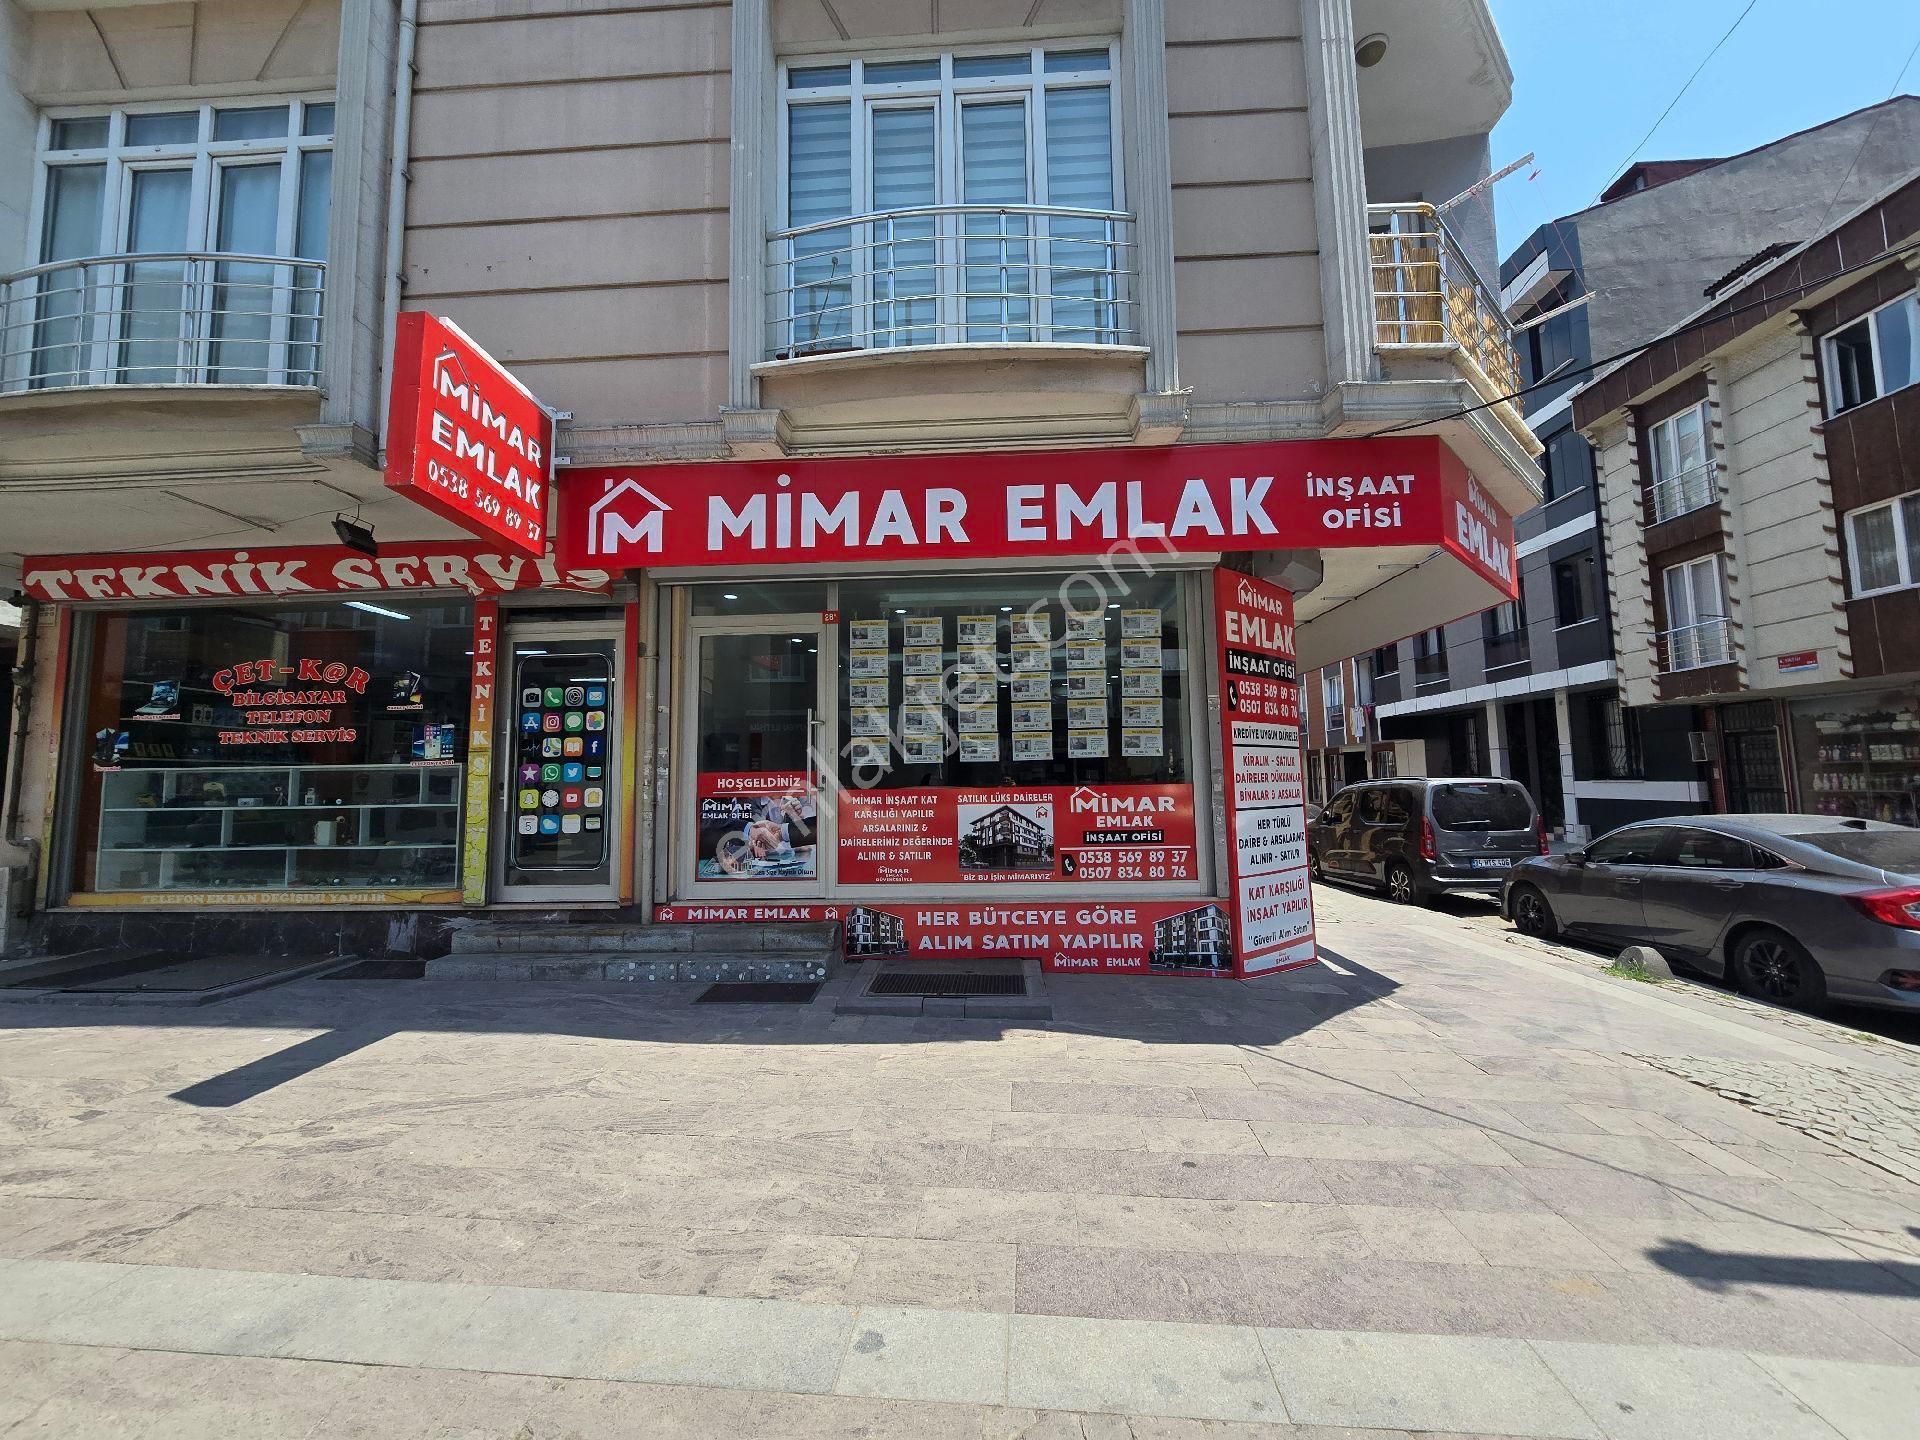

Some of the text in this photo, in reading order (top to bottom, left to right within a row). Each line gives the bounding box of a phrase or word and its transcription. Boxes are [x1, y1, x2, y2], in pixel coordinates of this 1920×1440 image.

[441, 367, 542, 468] MİMAR
[432, 408, 542, 511] EMLAK
[1306, 472, 1415, 502] İNŞAAT
[428, 458, 541, 541] 0538 569 89 37
[707, 474, 969, 551] MİMAR
[1006, 476, 1279, 542] EMLAK
[1322, 501, 1402, 529] OFİSİ
[1455, 500, 1512, 584] EMLAK
[25, 542, 610, 600] TEKNİK SERVİS
[1240, 587, 1284, 616] MİMAR
[1225, 610, 1295, 656] EMLAK
[1229, 650, 1295, 680] İNŞAAT OFİSİ
[472, 616, 493, 747] TEKNİK
[1239, 680, 1261, 697] 0538
[1264, 683, 1278, 698] 569
[232, 688, 347, 706] BİLGİSAYAR
[1239, 698, 1261, 714] 0507
[246, 709, 332, 725] TELEFON
[218, 727, 357, 745] TEKNİK SERVİS
[1243, 752, 1269, 767] KİRALIK
[717, 775, 801, 791] HOŞGELDİNİZ
[1236, 769, 1269, 783] DAİRELER
[852, 793, 938, 807] MİMAR İNŞAAT KAT
[957, 791, 1053, 803] SATILIK LÜKS DAİRELER
[1076, 792, 1176, 813] MİMAR
[1240, 788, 1269, 801] BİNALAR
[704, 802, 752, 811] MİMAR
[854, 808, 934, 819] KARŞILIĞI YAPILIR
[731, 811, 752, 819] OFİSİ
[1096, 815, 1154, 828] EMLAK
[1257, 815, 1291, 830] HER TÜRLÜ
[862, 823, 929, 833] ARSALARINIZ &
[840, 835, 953, 847] DAİRELERİNİZ DEĞERİNDE
[1086, 830, 1162, 843] İNŞAAT OFİSİ
[1238, 835, 1260, 849] DAİRE
[857, 851, 932, 861] ALINIR & SATILIR
[1079, 850, 1188, 864] 0538 569 89 37
[1250, 852, 1273, 866] ALINIR
[978, 873, 989, 881] BU
[990, 872, 1006, 882] İŞİN
[1079, 865, 1187, 879] 0507 834 80 76
[142, 895, 205, 906] TELEFON
[205, 894, 257, 905] EKRAN
[1248, 885, 1265, 901] KAT
[687, 907, 748, 920] MİMAR
[754, 908, 811, 919] EMLAK
[917, 905, 1137, 926] HER BÜTCEYE GÖRE
[1246, 898, 1309, 924] İNŞAAT YAPILIR
[918, 934, 1144, 950] ALIM SATIM YAPILIR
[1058, 956, 1141, 967] MİMAR EMLAK
